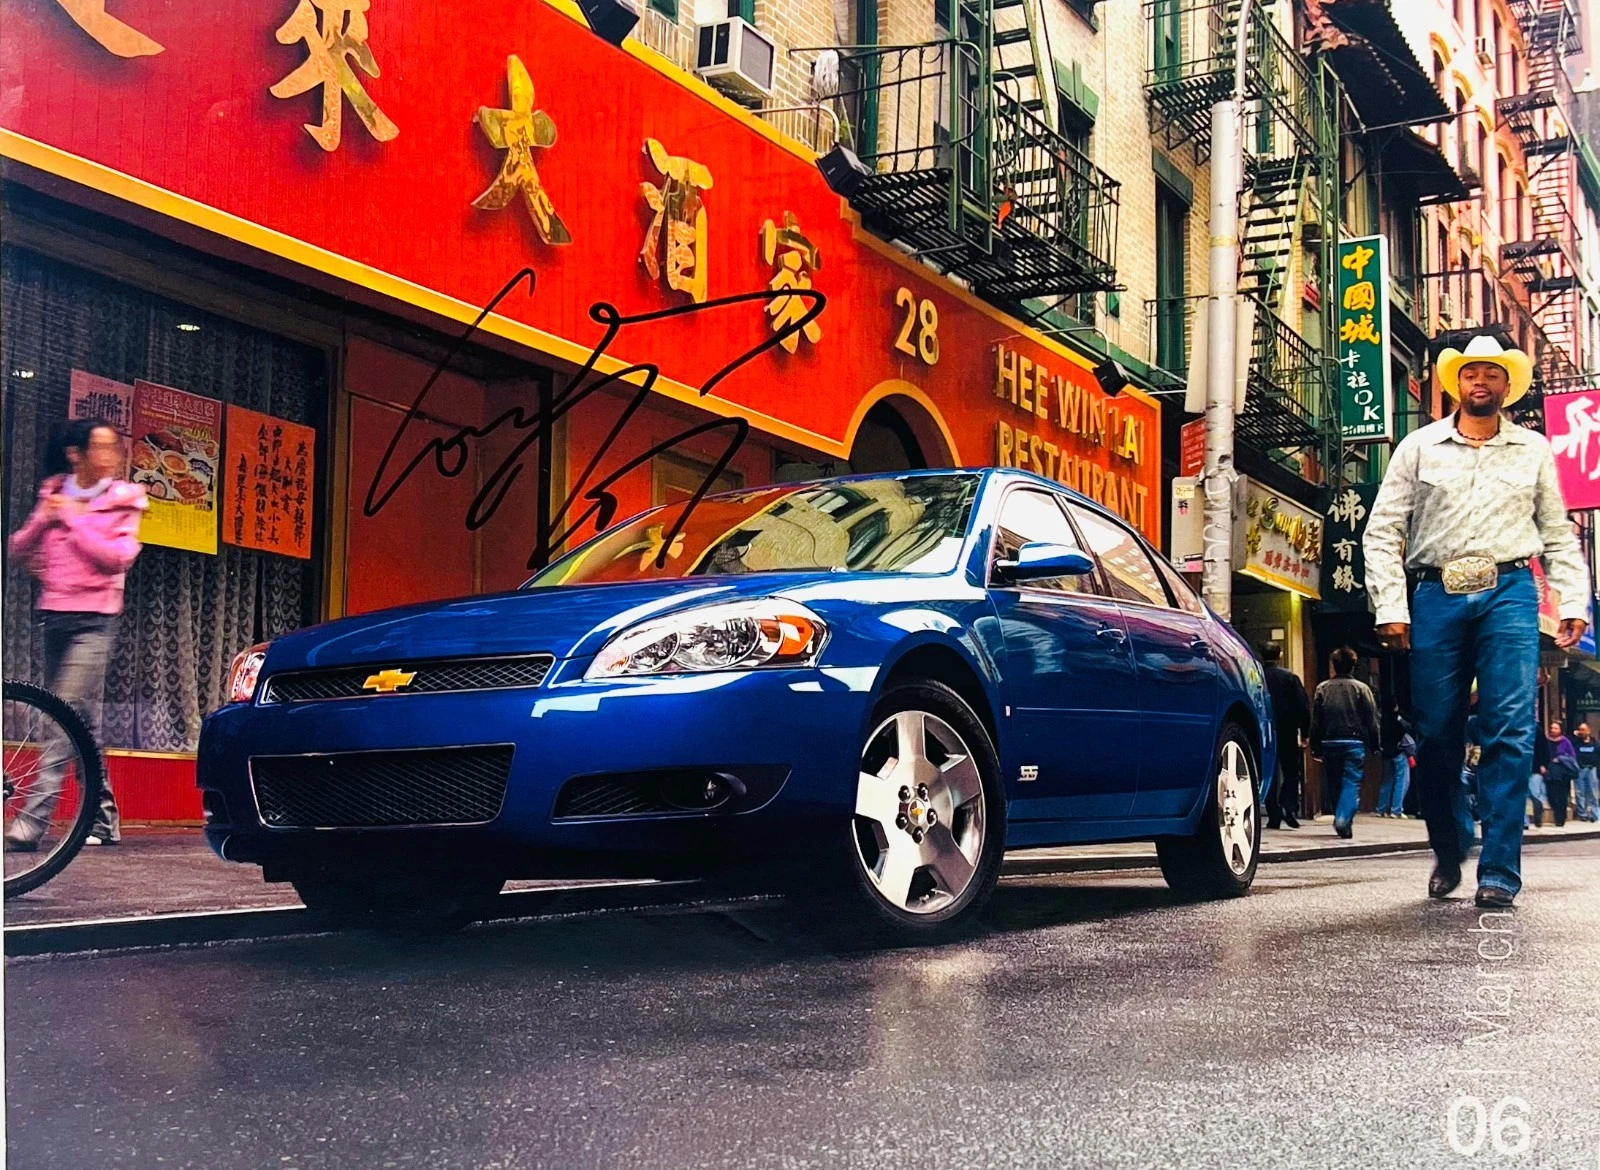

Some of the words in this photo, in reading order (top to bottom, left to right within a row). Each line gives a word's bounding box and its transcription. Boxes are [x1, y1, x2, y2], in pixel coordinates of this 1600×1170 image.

[894, 287, 939, 366] 28
[1339, 245, 1381, 345] 中國城
[996, 343, 1049, 420] HEE
[1055, 375, 1107, 446] WIN
[1341, 349, 1380, 422] 卡拉OK
[997, 420, 1149, 534] RESTAURANT
[1327, 488, 1366, 594] 佛有緣
[1016, 765, 1039, 782] SS
